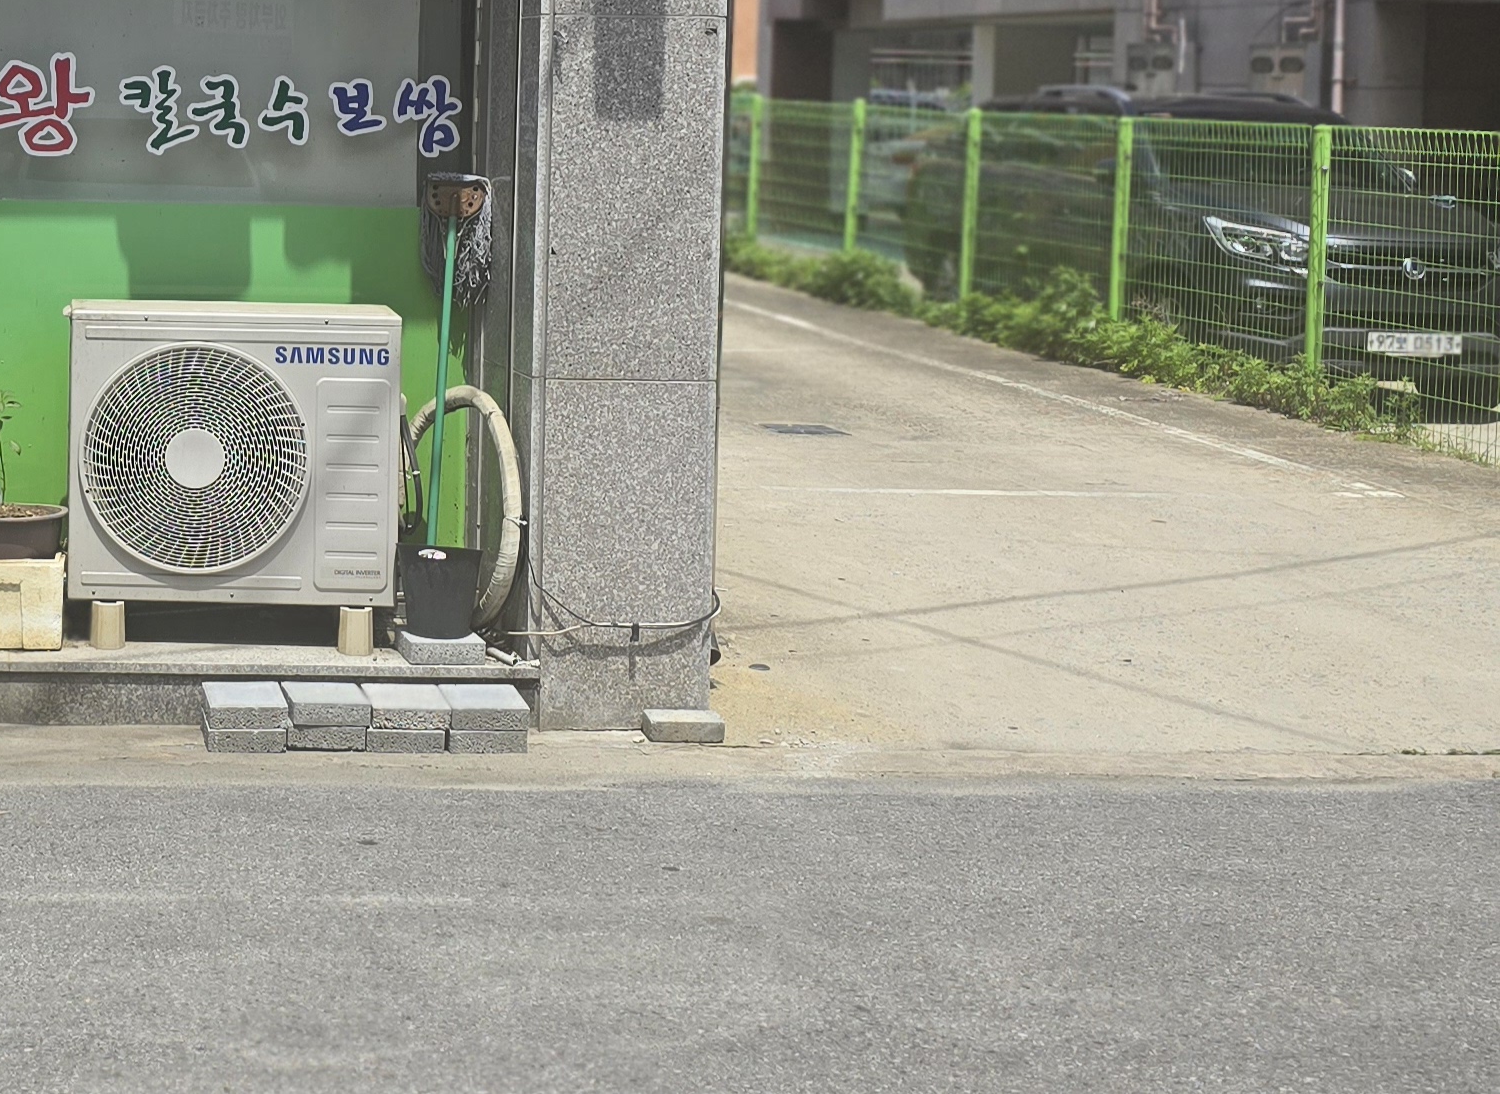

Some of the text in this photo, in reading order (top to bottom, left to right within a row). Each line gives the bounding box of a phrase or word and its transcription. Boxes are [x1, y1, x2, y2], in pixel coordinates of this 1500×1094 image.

[119, 65, 309, 155] 칼국수
[329, 75, 462, 157] 보쌈
[274, 345, 390, 367] SAMSUNG
